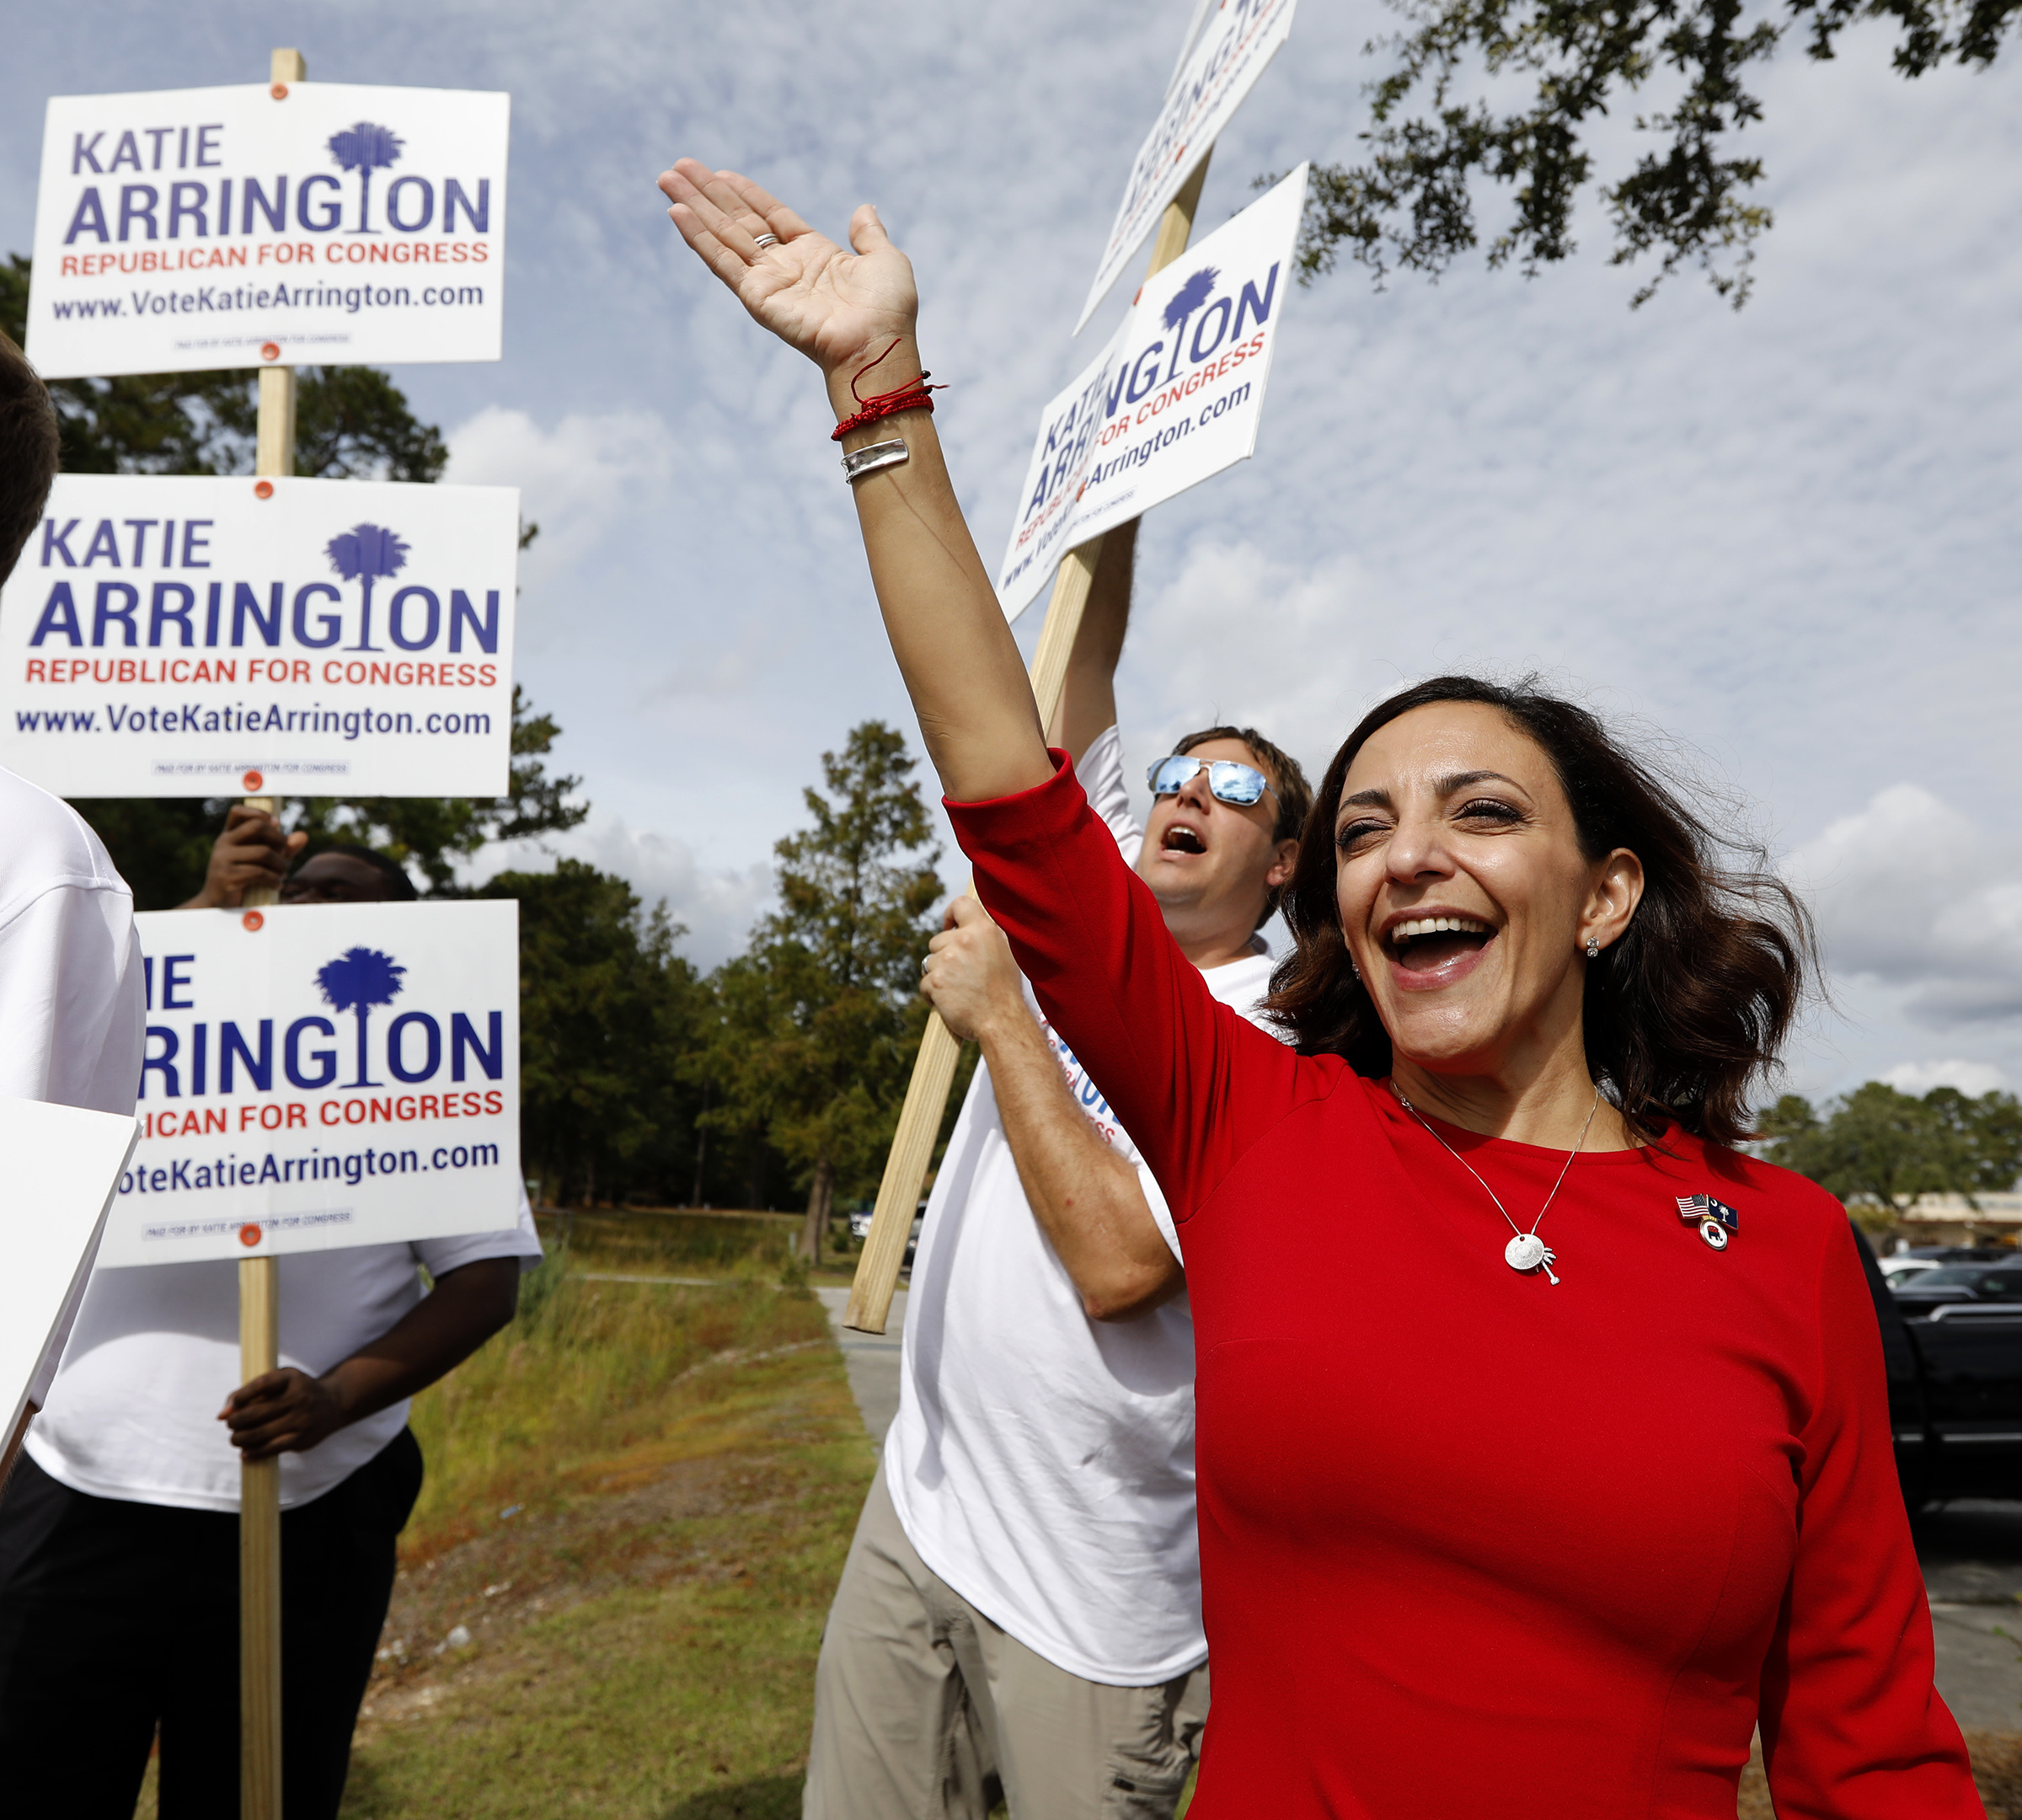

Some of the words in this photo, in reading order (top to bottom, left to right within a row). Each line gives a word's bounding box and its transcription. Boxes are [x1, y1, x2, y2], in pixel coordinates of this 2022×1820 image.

[72, 124, 223, 174] KATIE
[64, 174, 489, 245] ARRINGTON
[61, 245, 247, 276] REPUBLICAN
[258, 243, 314, 265] FOR
[325, 242, 489, 264] CONGRESS
[53, 281, 483, 320] www.VoteKatieArrington.com
[1042, 353, 1116, 462] KATIE
[1092, 416, 1131, 458] FOR
[1137, 332, 1265, 425] CONGRESS
[40, 518, 214, 568] KATIE
[29, 581, 500, 654] ARRINGTON
[26, 659, 237, 683] REPUBLICAN
[249, 659, 311, 683] FOR
[324, 661, 497, 688] CONGRESS
[16, 703, 490, 740] www.VoteKatieArrington.com
[137, 1010, 504, 1100] RINGTON
[240, 1103, 308, 1132] FOR
[320, 1090, 503, 1127] CONGRESS
[117, 1143, 499, 1195] oteKatieArrington.com
